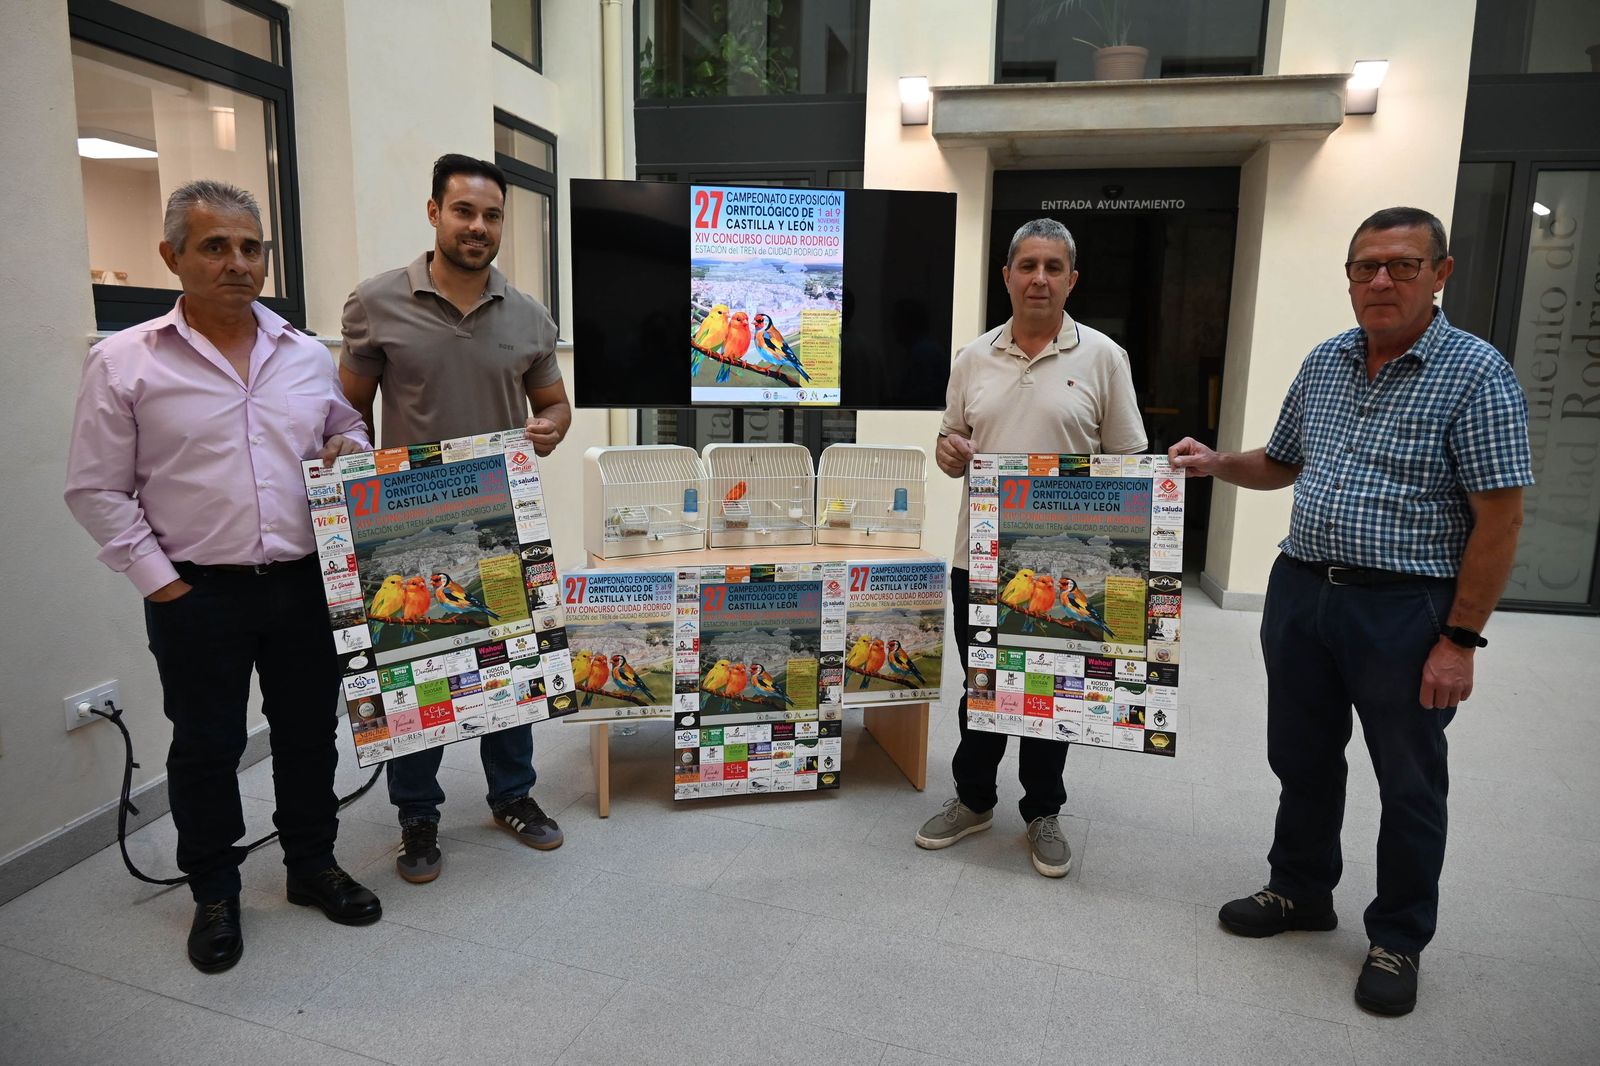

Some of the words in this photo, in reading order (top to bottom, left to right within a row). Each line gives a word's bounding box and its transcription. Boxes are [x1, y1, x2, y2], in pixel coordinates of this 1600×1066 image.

[727, 192, 786, 204] CAMPEONATO
[790, 193, 841, 206] EXPOSICIÓN
[695, 190, 723, 228] 27
[726, 204, 799, 217] ORNITOLÓGICO
[802, 208, 813, 217] DE
[1042, 200, 1092, 210] ENTRADA
[1096, 200, 1185, 209] AYUNTAMIENTO
[836, 209, 841, 217] 9
[726, 219, 774, 230] CASTILLA
[778, 220, 785, 230] Y
[788, 219, 814, 231] LEÓN
[695, 232, 710, 243] XIV
[713, 233, 762, 244] CONCURSO
[765, 234, 797, 245] CIUDAD
[801, 236, 839, 246] RODRIGO
[740, 247, 756, 255] TREN
[768, 247, 792, 255] CIUDAD
[794, 248, 822, 256] RODRIGO
[384, 470, 447, 488] CAMPEONATO
[450, 459, 502, 476] EXPOSICIÓN
[385, 477, 462, 499] ORNITOLÓGICO
[464, 473, 476, 484] DE
[518, 476, 538, 485] saluda
[1034, 480, 1093, 490] CAMPEONATO
[1096, 479, 1148, 491] EXPOSICIÓN
[352, 480, 381, 516] 27
[388, 493, 438, 511] CASTILLA
[442, 490, 448, 500] Y
[452, 483, 479, 498] LEÓN
[1003, 480, 1030, 509] 27
[1033, 489, 1105, 500] ORNITOLÓGICO
[1108, 492, 1120, 500] DE
[1033, 501, 1080, 511] CASTILLA
[1084, 502, 1090, 511] Y
[1094, 500, 1120, 512] LEÓN
[435, 512, 459, 523] CIUDAD
[526, 562, 554, 575] FRUTAS
[912, 564, 944, 573] EXPOSICIÓN
[589, 576, 633, 585] CAMPEONATO
[635, 574, 672, 583] EXPOSICIÓN
[850, 566, 870, 592] 27
[871, 574, 918, 582] ORNITOLÓGICO
[566, 577, 587, 604] 27
[589, 584, 643, 594] ORNITOLÓGICO
[728, 585, 776, 594] CAMPEONATO
[778, 584, 819, 592] EXPOSICIÓN
[911, 580, 928, 590] LEÓN
[589, 595, 625, 604] CASTILLA
[634, 592, 653, 601] LEÓN
[704, 586, 727, 612] 27
[728, 593, 786, 602] ORNITOLÓGICO
[861, 592, 894, 600] CONCURSO
[1151, 595, 1180, 605] FRUTAS
[566, 605, 577, 614] XIV
[579, 604, 616, 613] CONCURSO
[618, 603, 641, 612] CIUDAD
[642, 603, 672, 611] RODRIGO
[728, 602, 766, 611] CASTILLA
[777, 600, 798, 609] LEÓN
[487, 666, 504, 674] KIOSCO
[489, 670, 509, 679] PICOTEO
